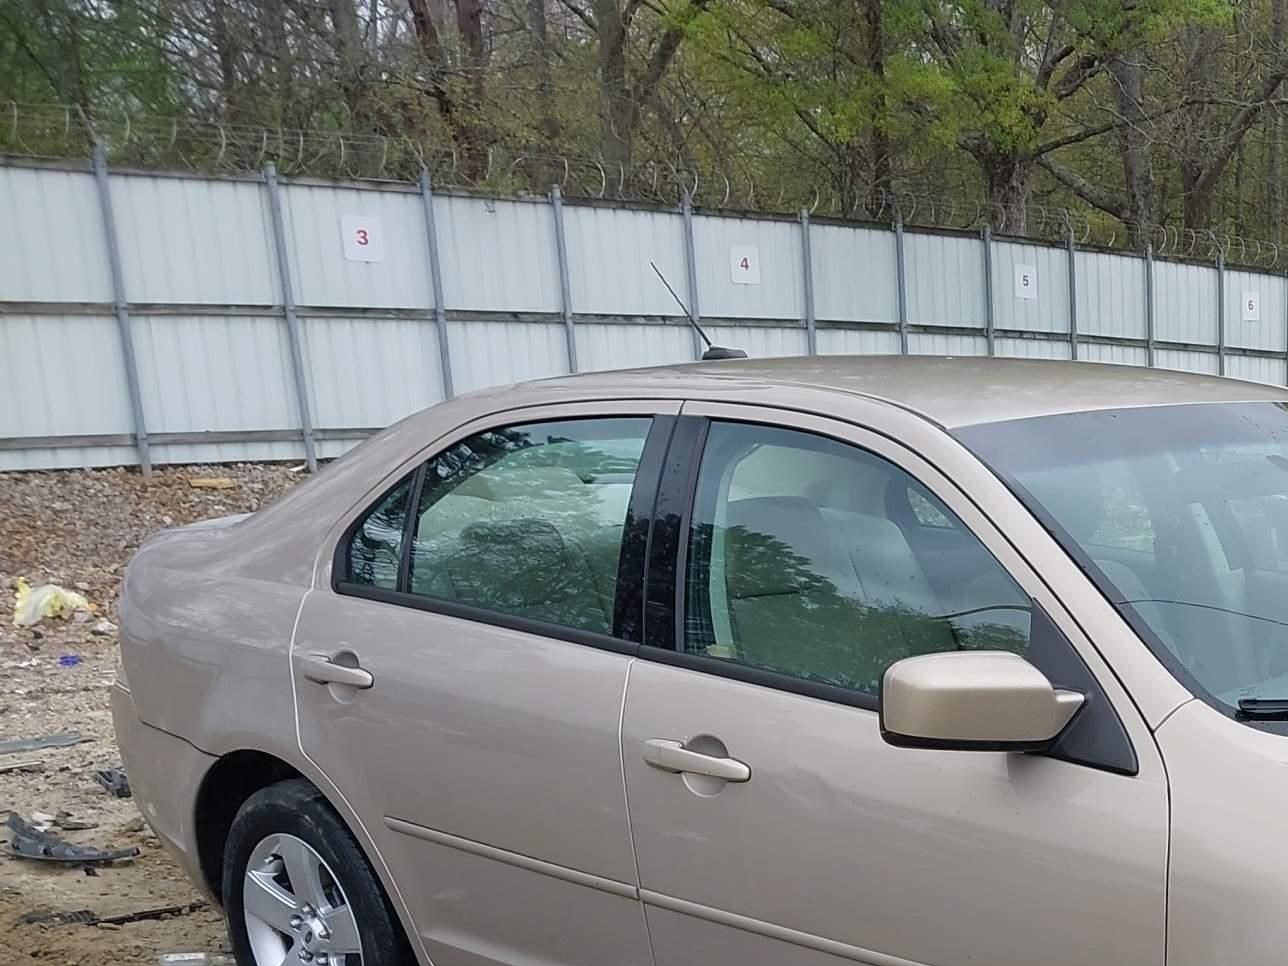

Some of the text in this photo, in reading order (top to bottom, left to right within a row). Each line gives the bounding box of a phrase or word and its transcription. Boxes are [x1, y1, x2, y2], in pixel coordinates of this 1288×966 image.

[356, 229, 369, 246] 3
[740, 257, 750, 271] 4
[1022, 275, 1029, 287] 5
[1248, 299, 1254, 311] 6
